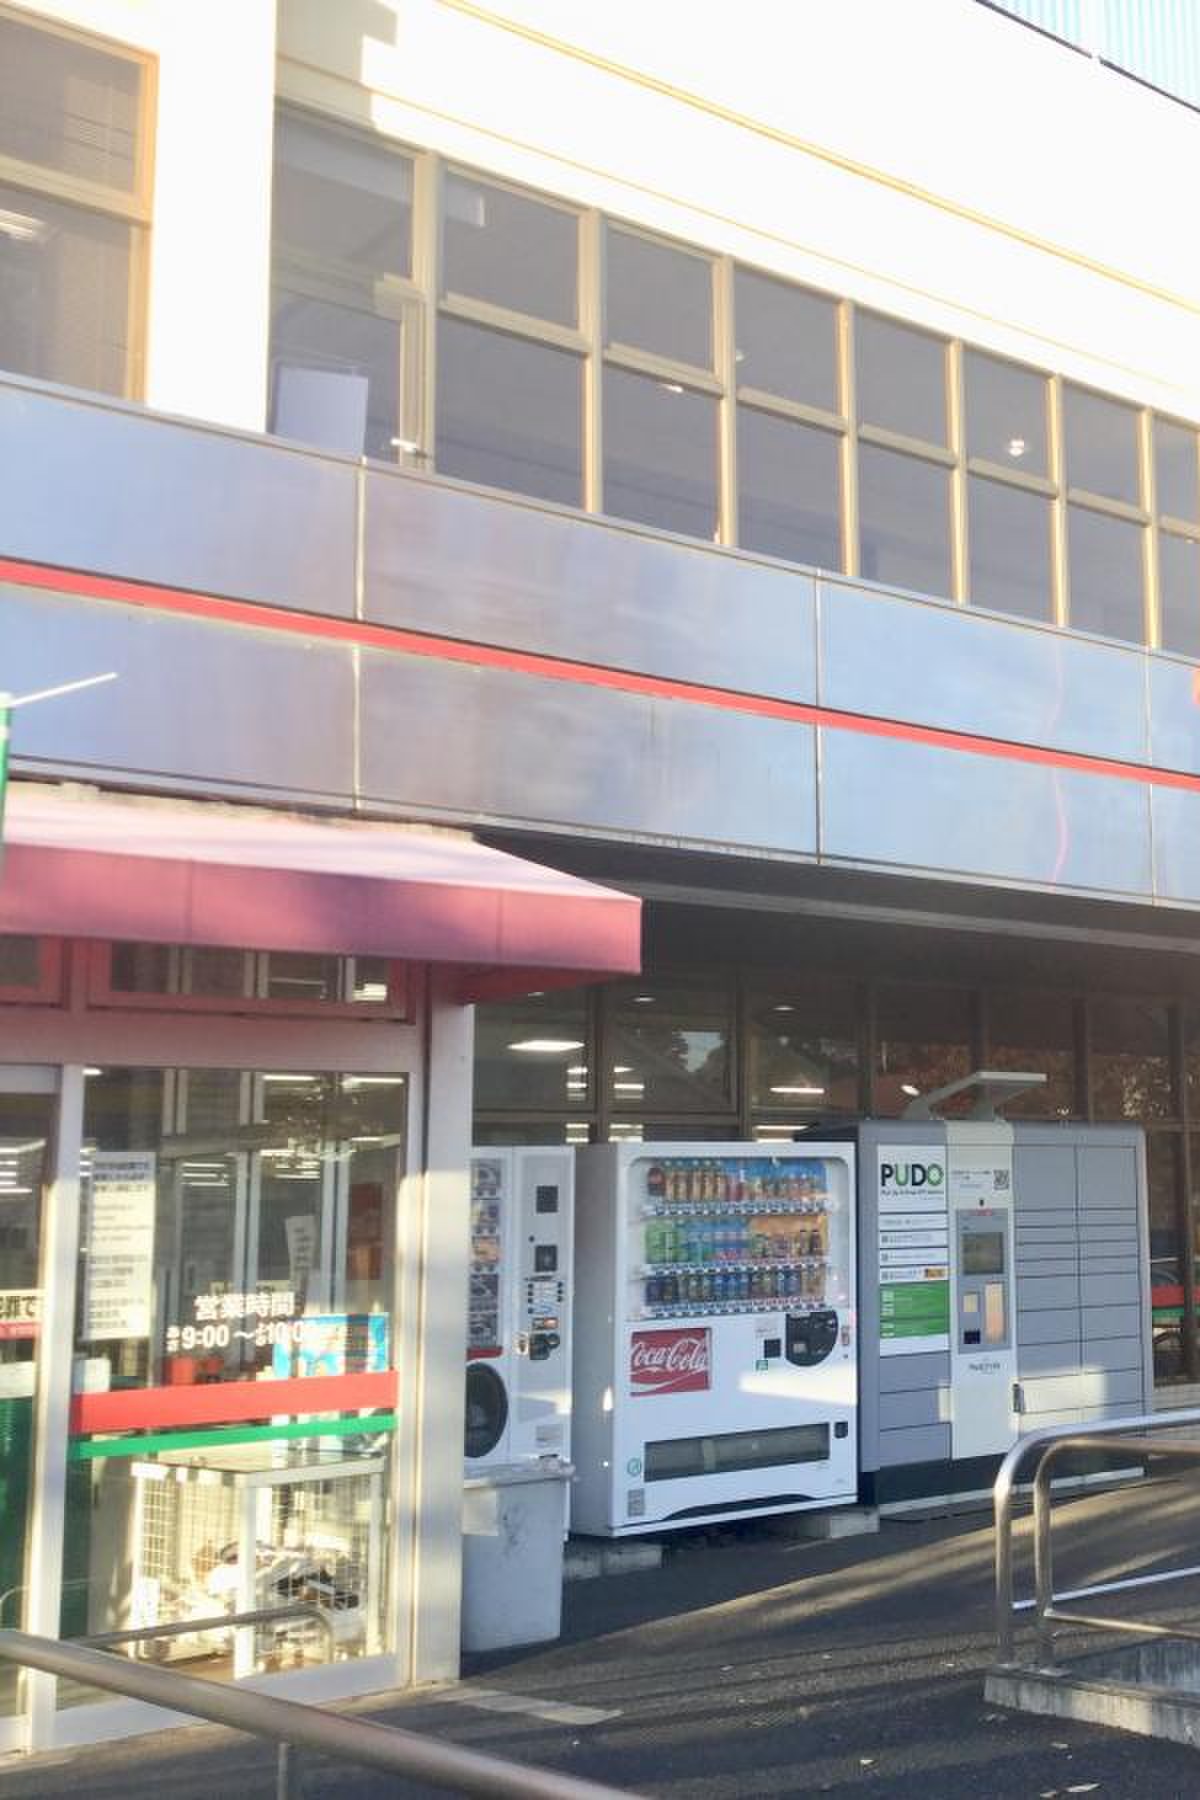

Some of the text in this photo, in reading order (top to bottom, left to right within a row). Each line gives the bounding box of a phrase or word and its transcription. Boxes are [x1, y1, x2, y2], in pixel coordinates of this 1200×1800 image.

[881, 1163, 945, 1187] PUDO
[194, 1291, 295, 1321] 営業時間
